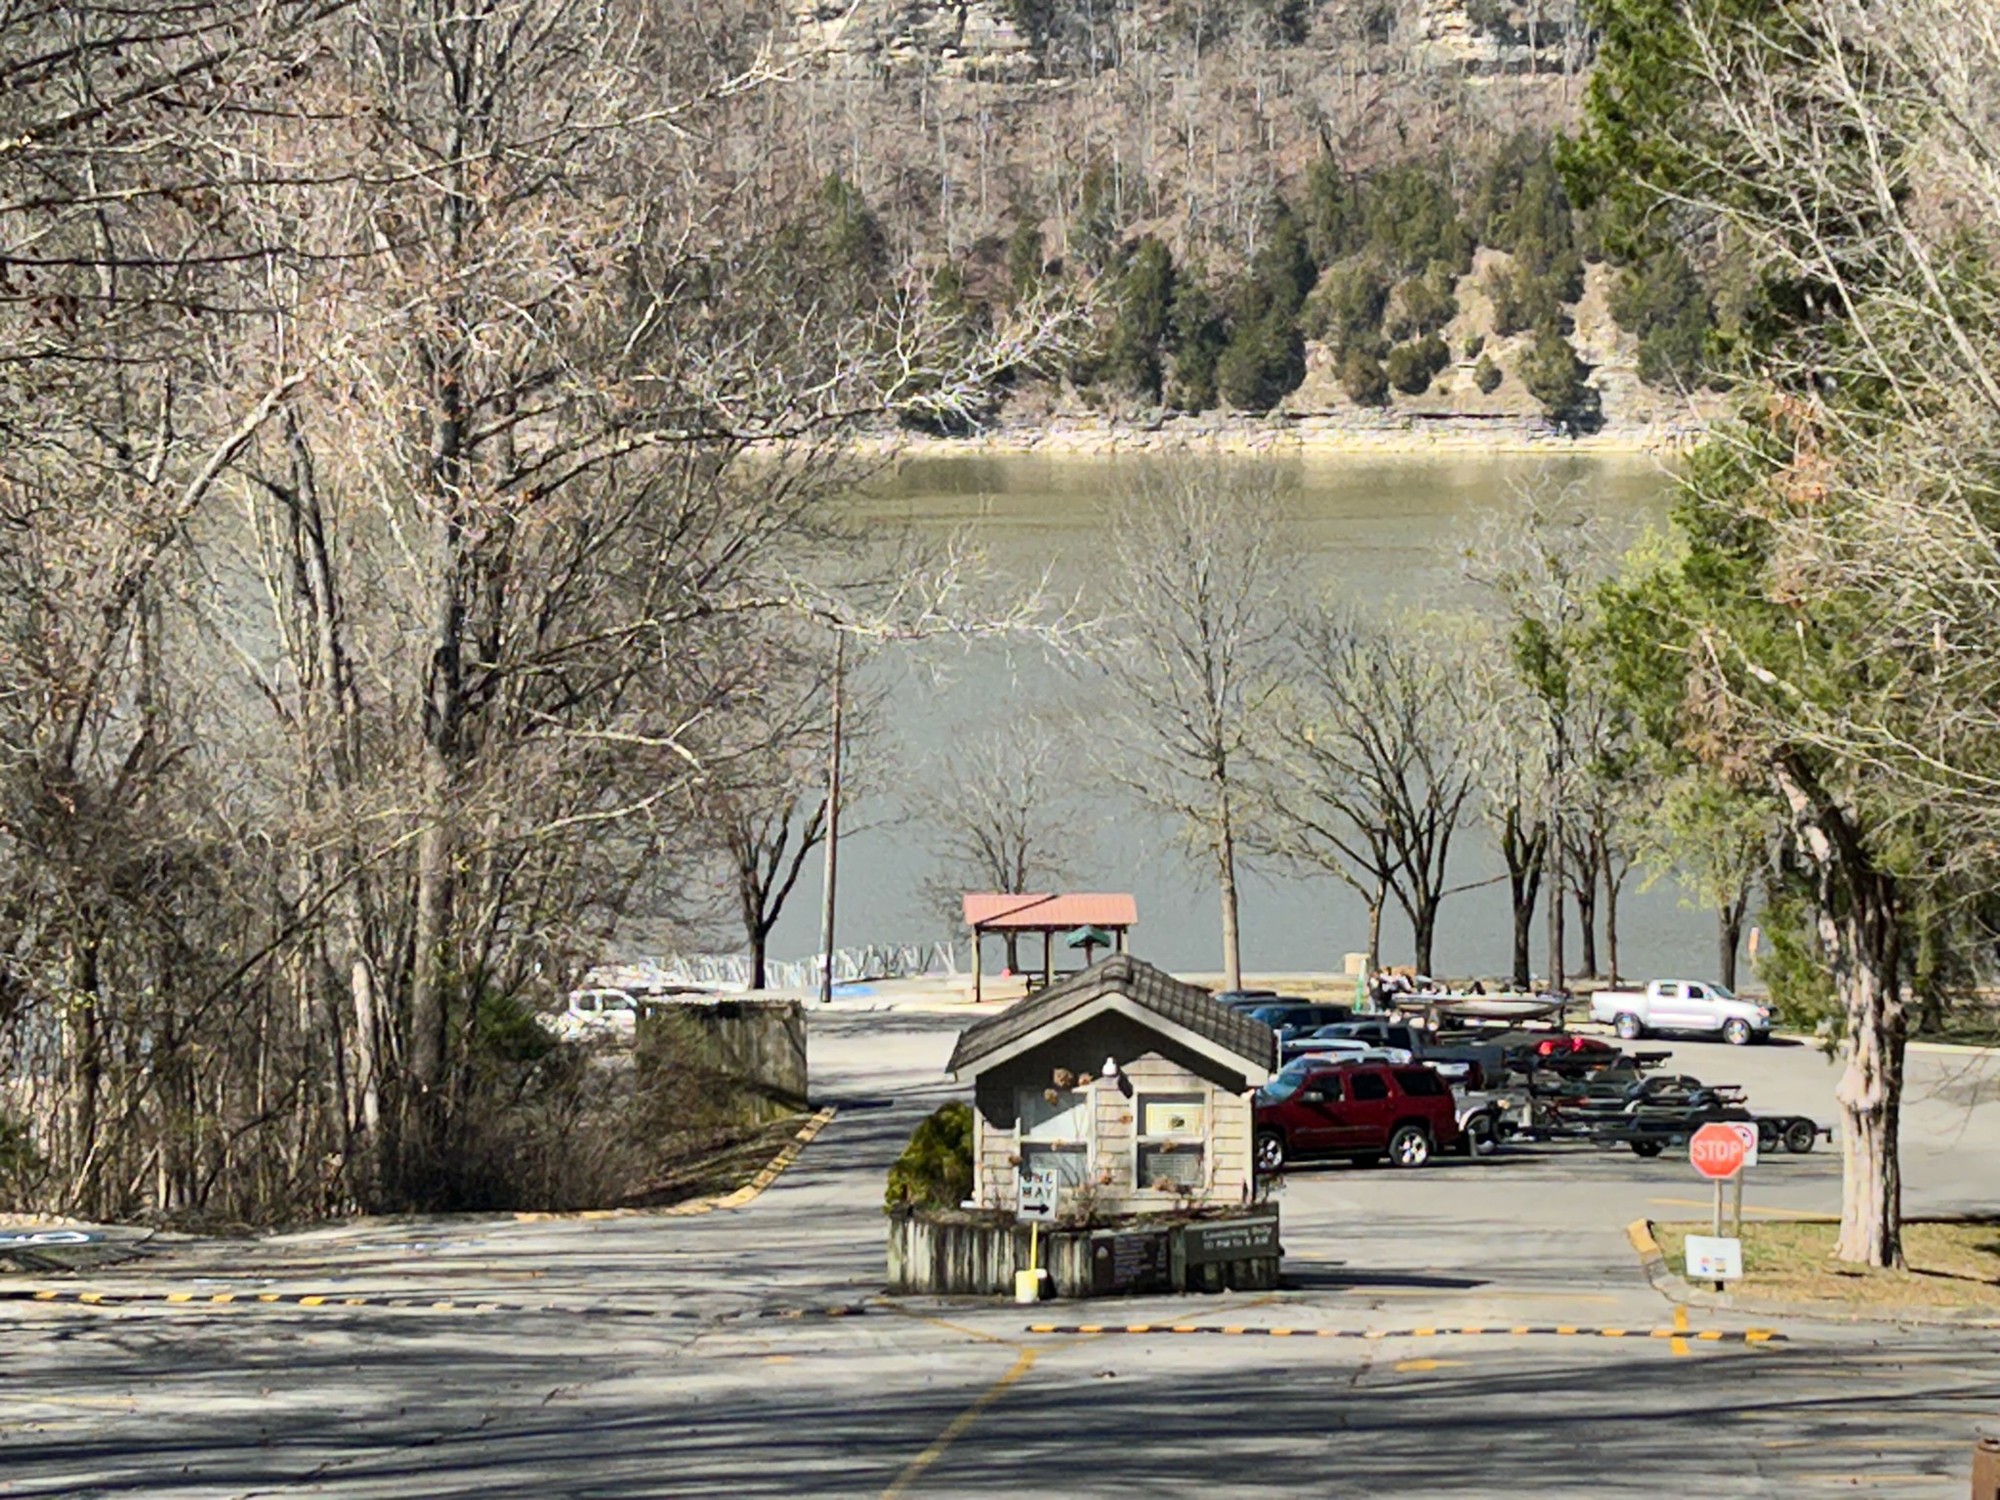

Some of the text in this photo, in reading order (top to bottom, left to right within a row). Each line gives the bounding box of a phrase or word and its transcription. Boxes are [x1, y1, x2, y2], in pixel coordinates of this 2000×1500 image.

[1695, 1140, 1741, 1161] STOP
[1022, 1171, 1053, 1183] ONE
[1022, 1186, 1053, 1199] WAY
